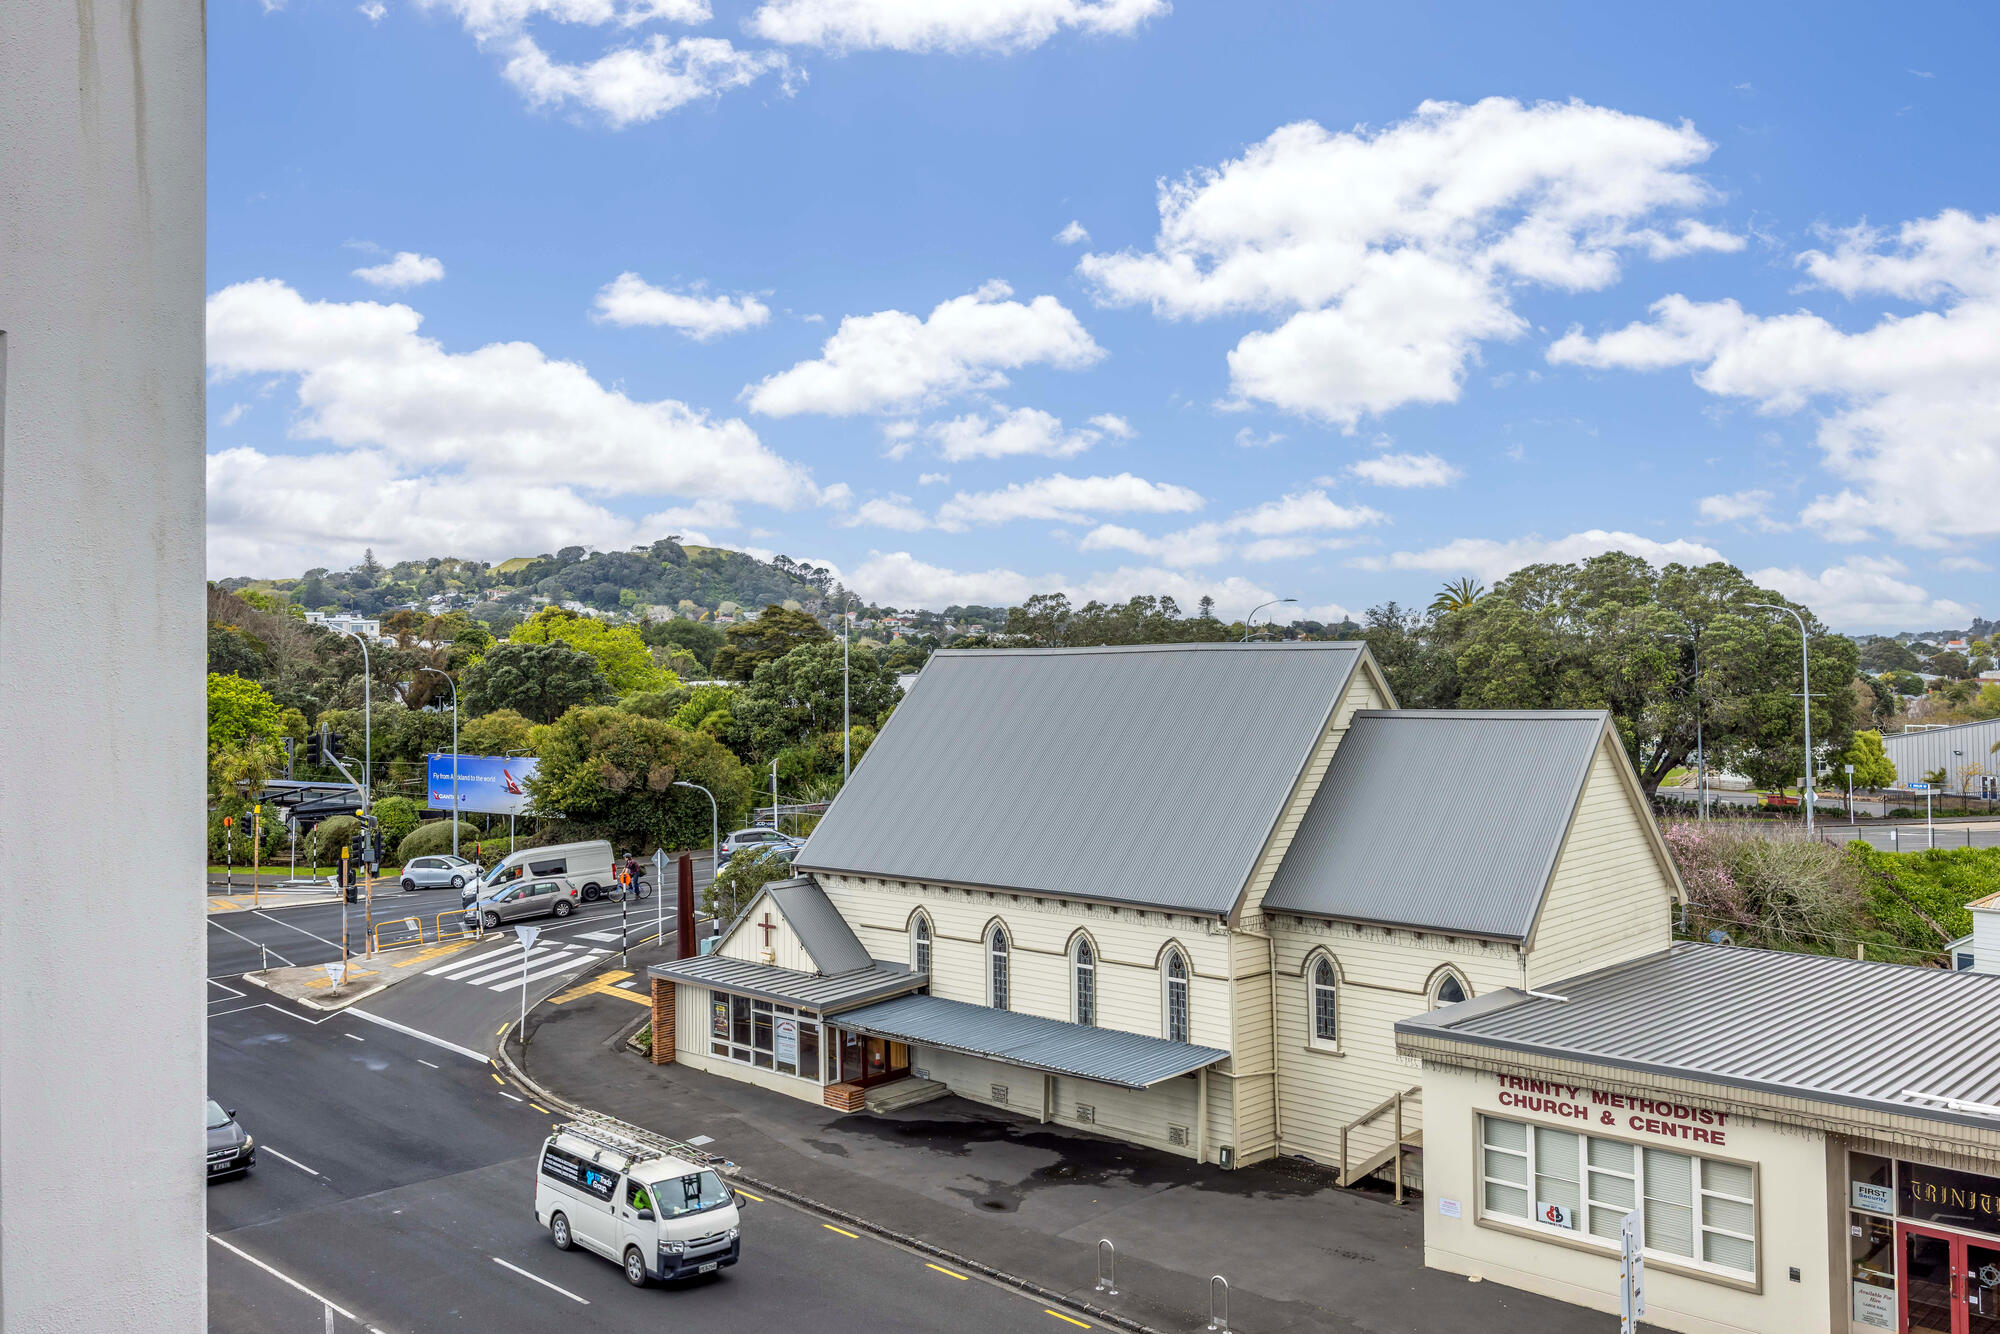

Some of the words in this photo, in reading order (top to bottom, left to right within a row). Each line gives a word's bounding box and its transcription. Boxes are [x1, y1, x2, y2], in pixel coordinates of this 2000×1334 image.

[1497, 1074, 1581, 1100] TRINITY
[1592, 1090, 1728, 1127] METHODIST
[1499, 1091, 1588, 1120] CHURCH
[1600, 1110, 1616, 1126] &
[1629, 1115, 1726, 1146] CENTRE
[1858, 1186, 1887, 1198] FIRST
[1858, 1192, 1888, 1204] Security
[1858, 1289, 1882, 1299] Available
